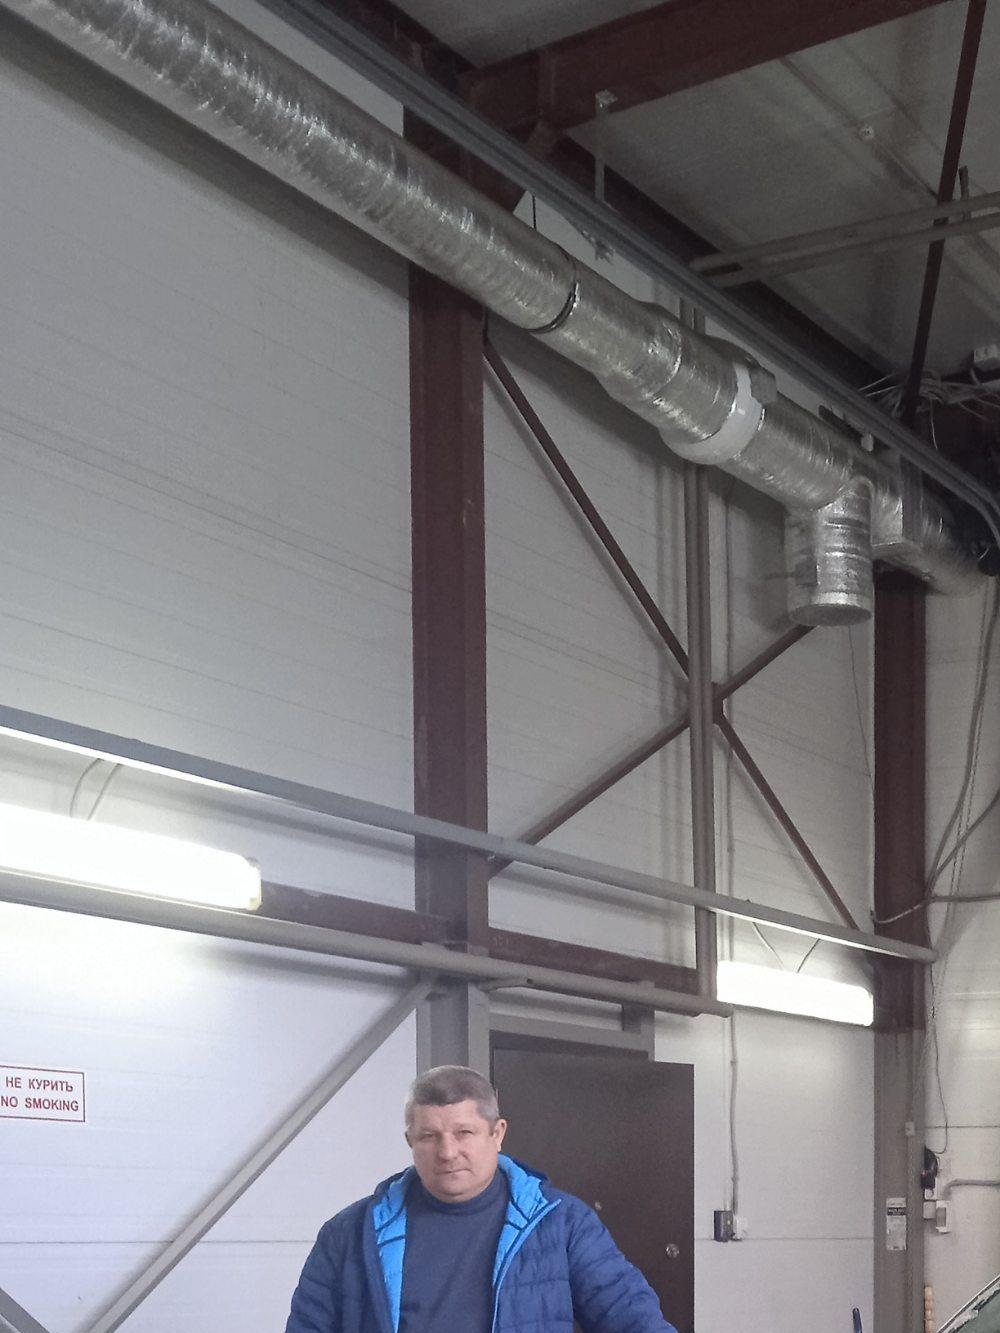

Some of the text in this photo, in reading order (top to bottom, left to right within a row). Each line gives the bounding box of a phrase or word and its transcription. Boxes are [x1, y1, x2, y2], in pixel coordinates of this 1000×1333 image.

[5, 1076, 74, 1093] НЕ КУРИТЬ
[1, 1095, 79, 1112] NO SMOKING
